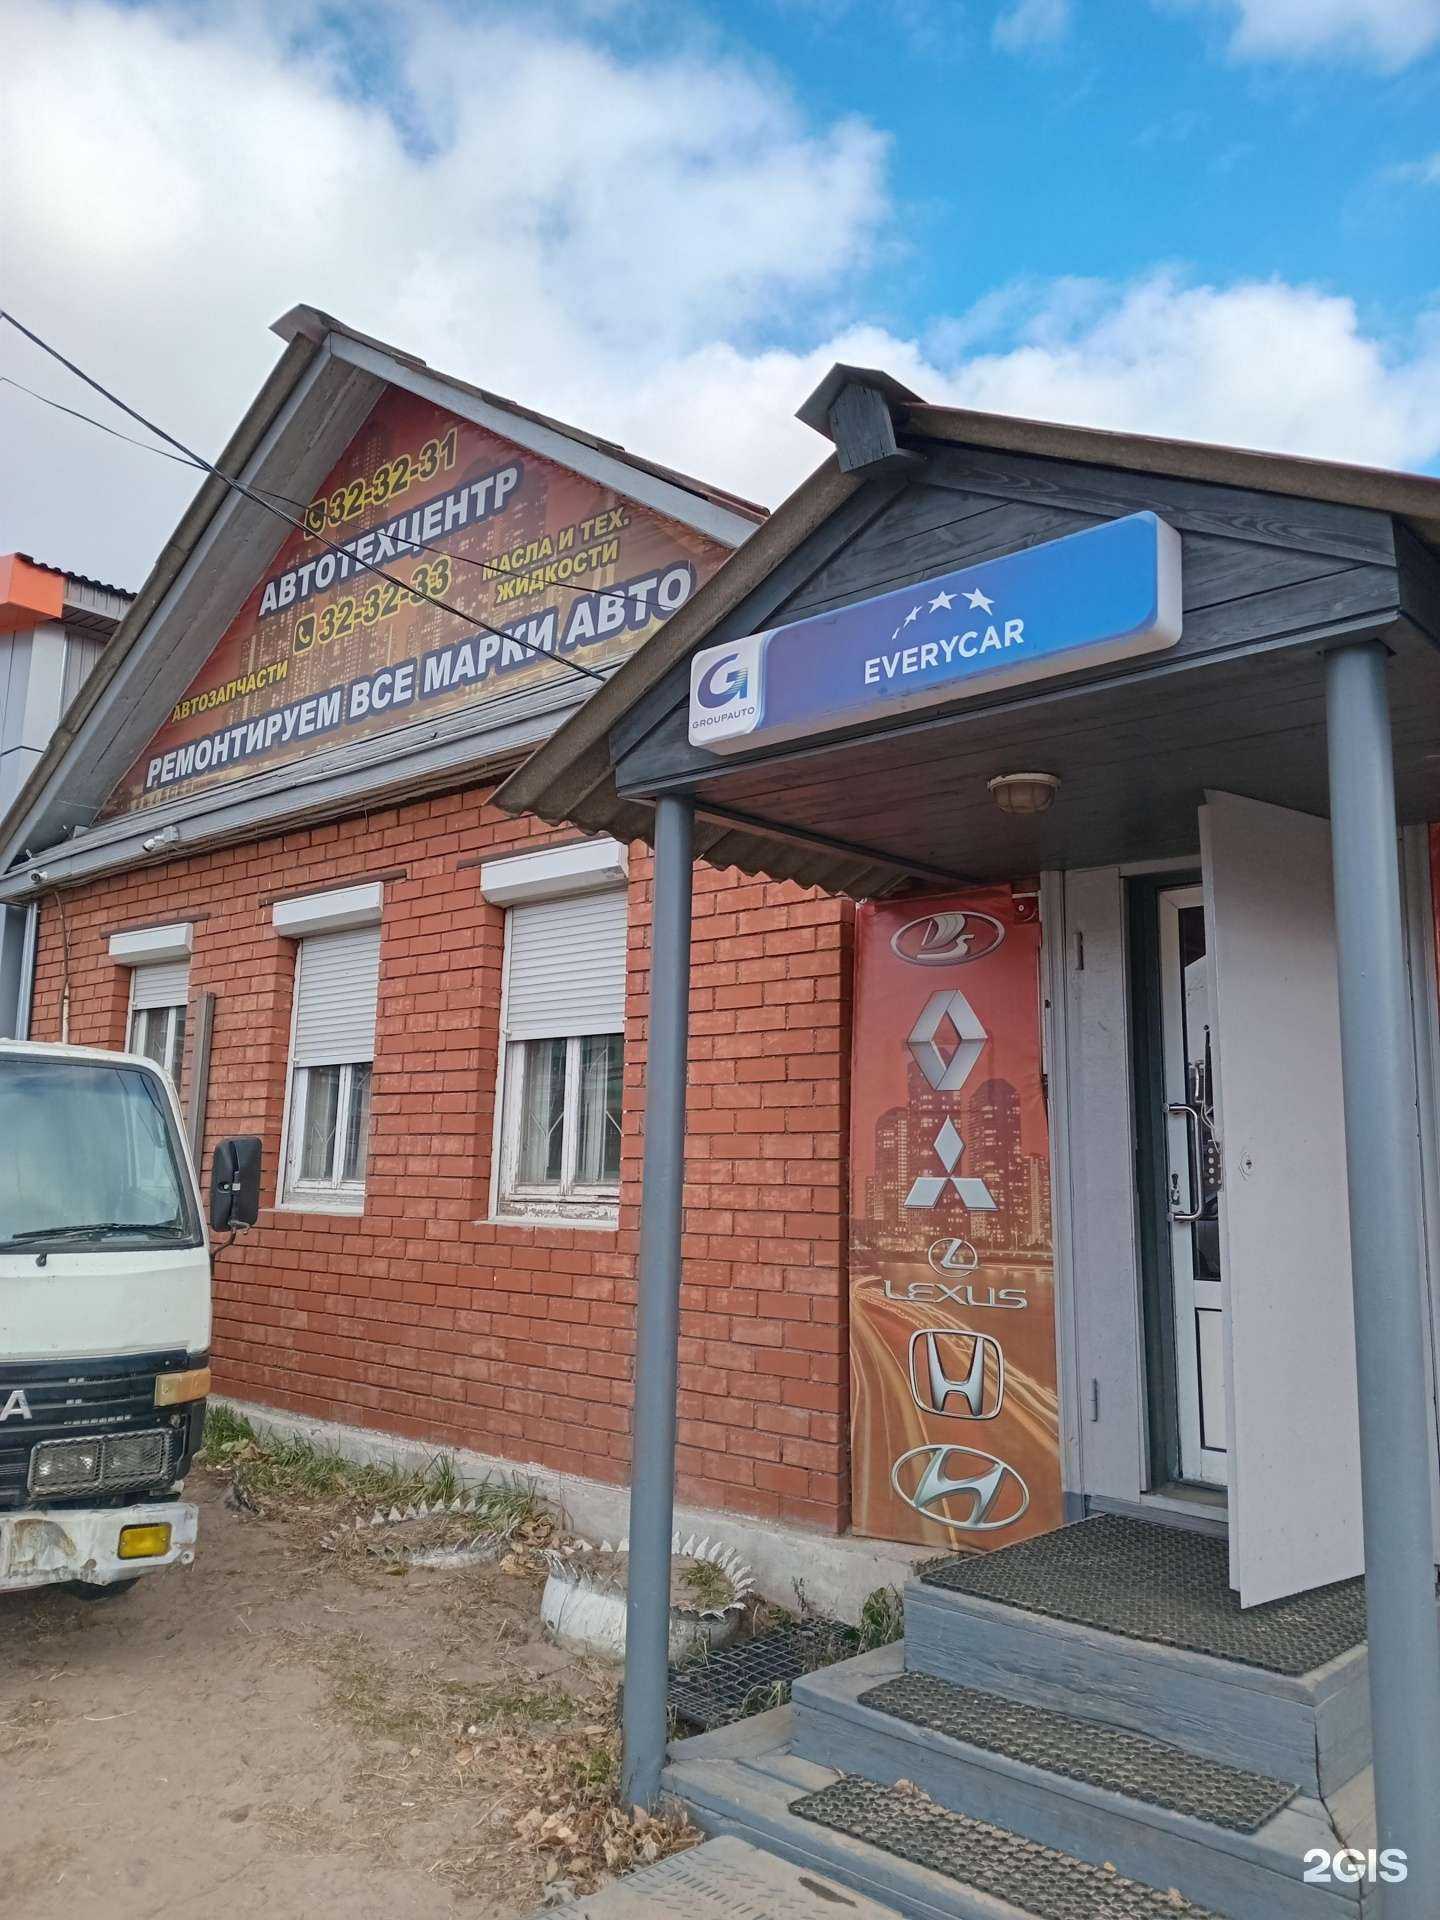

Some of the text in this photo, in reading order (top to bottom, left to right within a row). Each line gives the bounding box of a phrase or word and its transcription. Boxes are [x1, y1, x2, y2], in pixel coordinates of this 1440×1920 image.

[325, 427, 458, 528] 32-32-31
[259, 467, 518, 617] АВТОТЕХЦЕНТР
[482, 507, 629, 581] МАСЛА И ТЕХ.
[496, 540, 618, 603] ЖИДКОСТИ
[317, 554, 451, 645] 32-32-33
[146, 568, 692, 788] РЕМОНТИРУЕМ ВСЕ МАРКИ АВТО
[864, 619, 1025, 685] EVERYCAR
[172, 659, 288, 724] АВТОЗАПЧАСТИ
[692, 706, 755, 729] GROUPAUTO
[884, 1280, 1028, 1309] LEXUS
